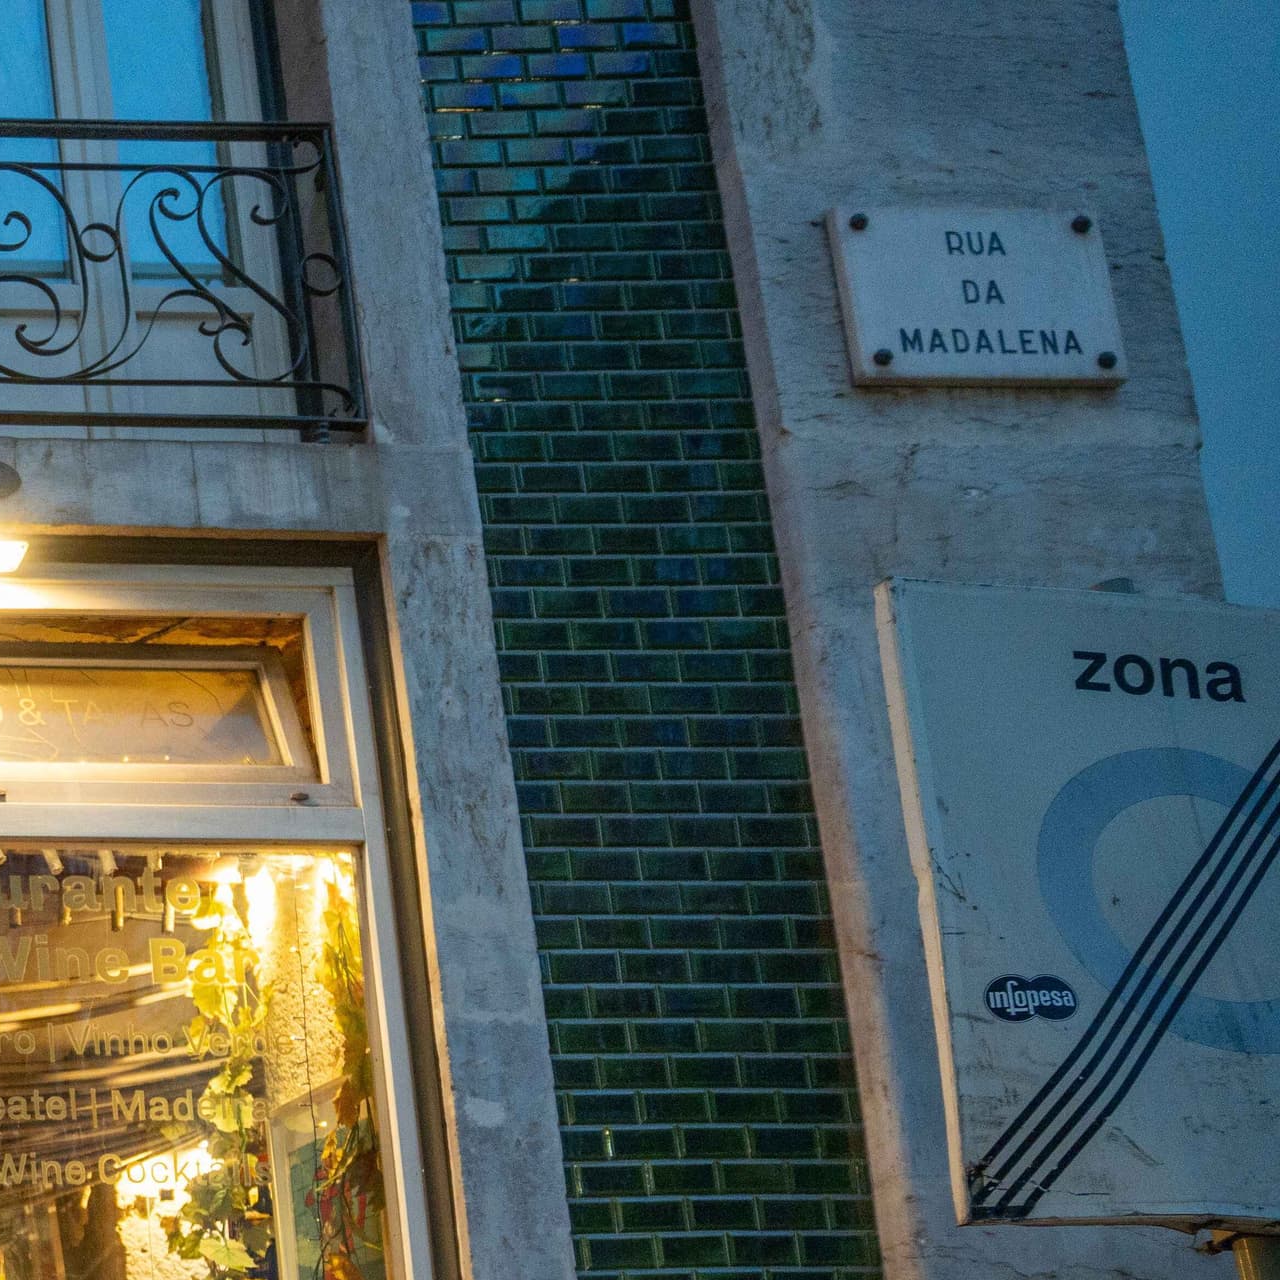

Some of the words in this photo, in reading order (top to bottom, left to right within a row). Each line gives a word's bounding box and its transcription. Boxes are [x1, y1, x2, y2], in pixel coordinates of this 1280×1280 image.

[945, 231, 1006, 256] RUA
[962, 280, 1005, 304] DA
[900, 328, 1084, 355] MADALENA
[1073, 650, 1246, 703] zona
[18, 697, 46, 726] &
[64, 698, 195, 728] TAAS
[149, 937, 260, 986] Bar
[989, 980, 1075, 1015] infopesa
[64, 1023, 172, 1056] Vinho
